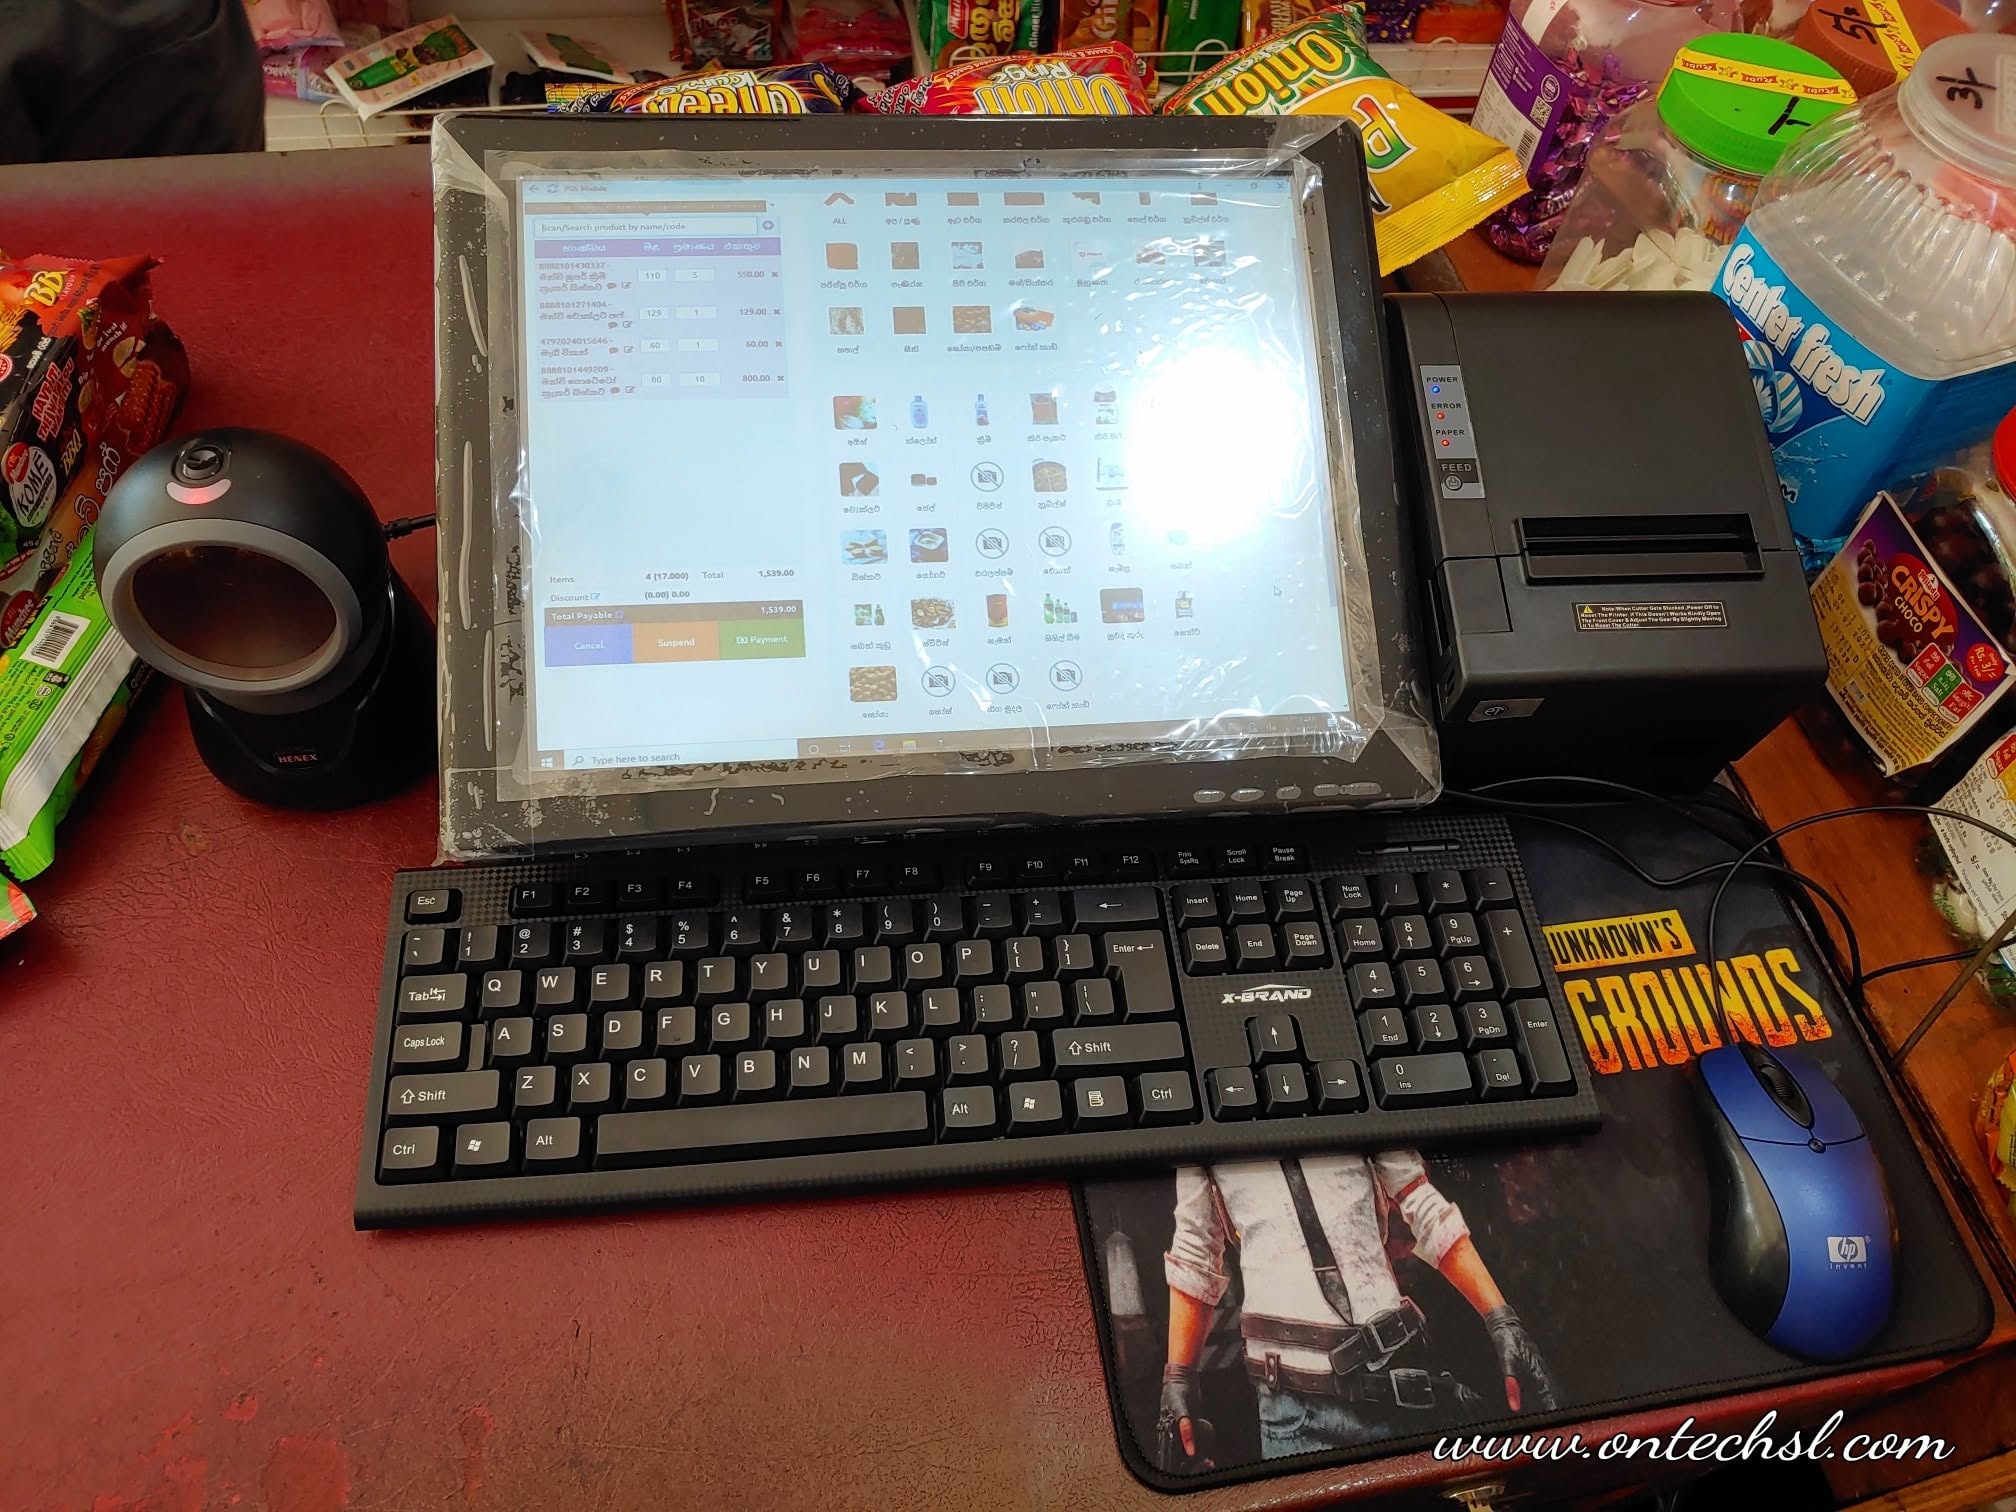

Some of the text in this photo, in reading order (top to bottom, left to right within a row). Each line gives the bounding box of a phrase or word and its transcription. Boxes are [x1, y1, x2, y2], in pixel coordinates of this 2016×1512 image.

[1203, 33, 1343, 115] Onion
[832, 216, 847, 224] ALL
[542, 222, 685, 232] Scan/Search product by name/code
[646, 272, 660, 280] 110
[737, 271, 765, 279] 550.00
[1723, 243, 1804, 355] Center
[647, 309, 661, 317] 129
[739, 308, 767, 316] 129.00
[746, 340, 768, 348] 60.00
[742, 374, 770, 382] 800.00
[1441, 463, 1472, 472] FEED
[654, 572, 689, 581] (17.000)
[702, 571, 724, 579] Total
[759, 569, 794, 578] 1,539.00
[550, 576, 574, 584] Items
[551, 593, 589, 602] Discount
[645, 591, 669, 600] (0.00)
[1891, 565, 1955, 639] CRISPY
[760, 606, 797, 614] 1,539.00
[1894, 596, 1923, 633] CHOCO
[551, 611, 613, 620] Total Payable
[658, 638, 695, 648] Suspend
[750, 635, 788, 645] Payment
[574, 640, 604, 650] Cancel
[1913, 661, 1930, 681] Sugar
[1931, 682, 1944, 698] Salt
[278, 752, 319, 764] HENEX
[592, 752, 680, 765] Type here to search
[1027, 861, 1043, 869] F10
[1074, 858, 1089, 867] F11
[1123, 856, 1140, 865] F12
[905, 867, 918, 876] F8
[979, 863, 992, 872] F9
[806, 873, 820, 882] F6
[856, 869, 869, 879] F7
[678, 880, 693, 890] F4
[755, 876, 769, 885] F5
[575, 887, 590, 896] F2
[627, 883, 642, 893] F3
[522, 890, 536, 900] F1
[1235, 894, 1258, 902] Home
[1284, 889, 1303, 898] Page
[1343, 891, 1362, 899] Lock
[417, 897, 436, 905] Esc
[1285, 895, 1296, 903] Up
[1294, 933, 1315, 942] Page
[1450, 936, 1472, 945] PgUp
[1195, 943, 1219, 951] Delete
[1247, 940, 1263, 948] End
[1353, 939, 1376, 947] Home
[1113, 943, 1135, 953] Enter
[408, 991, 429, 1001] Tab
[1221, 988, 1312, 1004] X-BRAND
[1527, 1020, 1548, 1029] Enter
[1478, 1026, 1501, 1035] PgDn
[404, 1036, 445, 1048] Caps Lock
[1382, 1034, 1399, 1042] End
[1084, 1041, 1112, 1053] Shift
[1399, 1081, 1412, 1089] Ins
[418, 1090, 446, 1101] Shift
[1151, 1088, 1172, 1100] Ctrl
[952, 1103, 969, 1115] Alt
[535, 1135, 553, 1146] Alt
[393, 1144, 415, 1156] Ctrl
[1839, 1238, 1859, 1260] hp
[1829, 1262, 1868, 1270] invent
